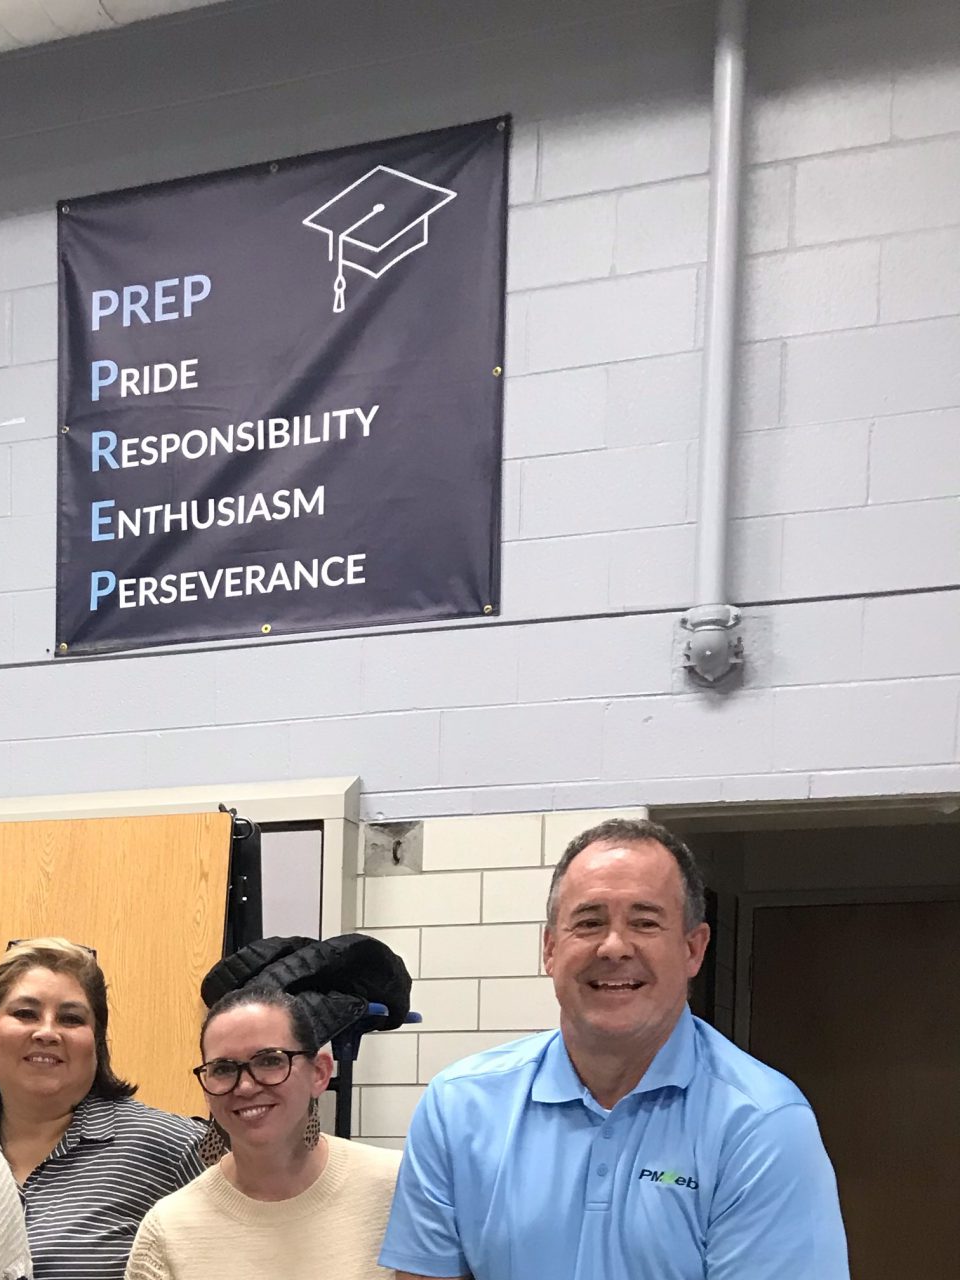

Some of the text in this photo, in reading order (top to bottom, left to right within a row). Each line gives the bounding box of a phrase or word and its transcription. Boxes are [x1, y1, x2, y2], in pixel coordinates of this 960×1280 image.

[91, 274, 212, 331] PREP
[91, 359, 199, 401] PRIDE
[91, 404, 380, 472] RESPONSIBILITY
[91, 485, 325, 542] ENTHUSIASM
[90, 553, 367, 611] PERSEVERANCE
